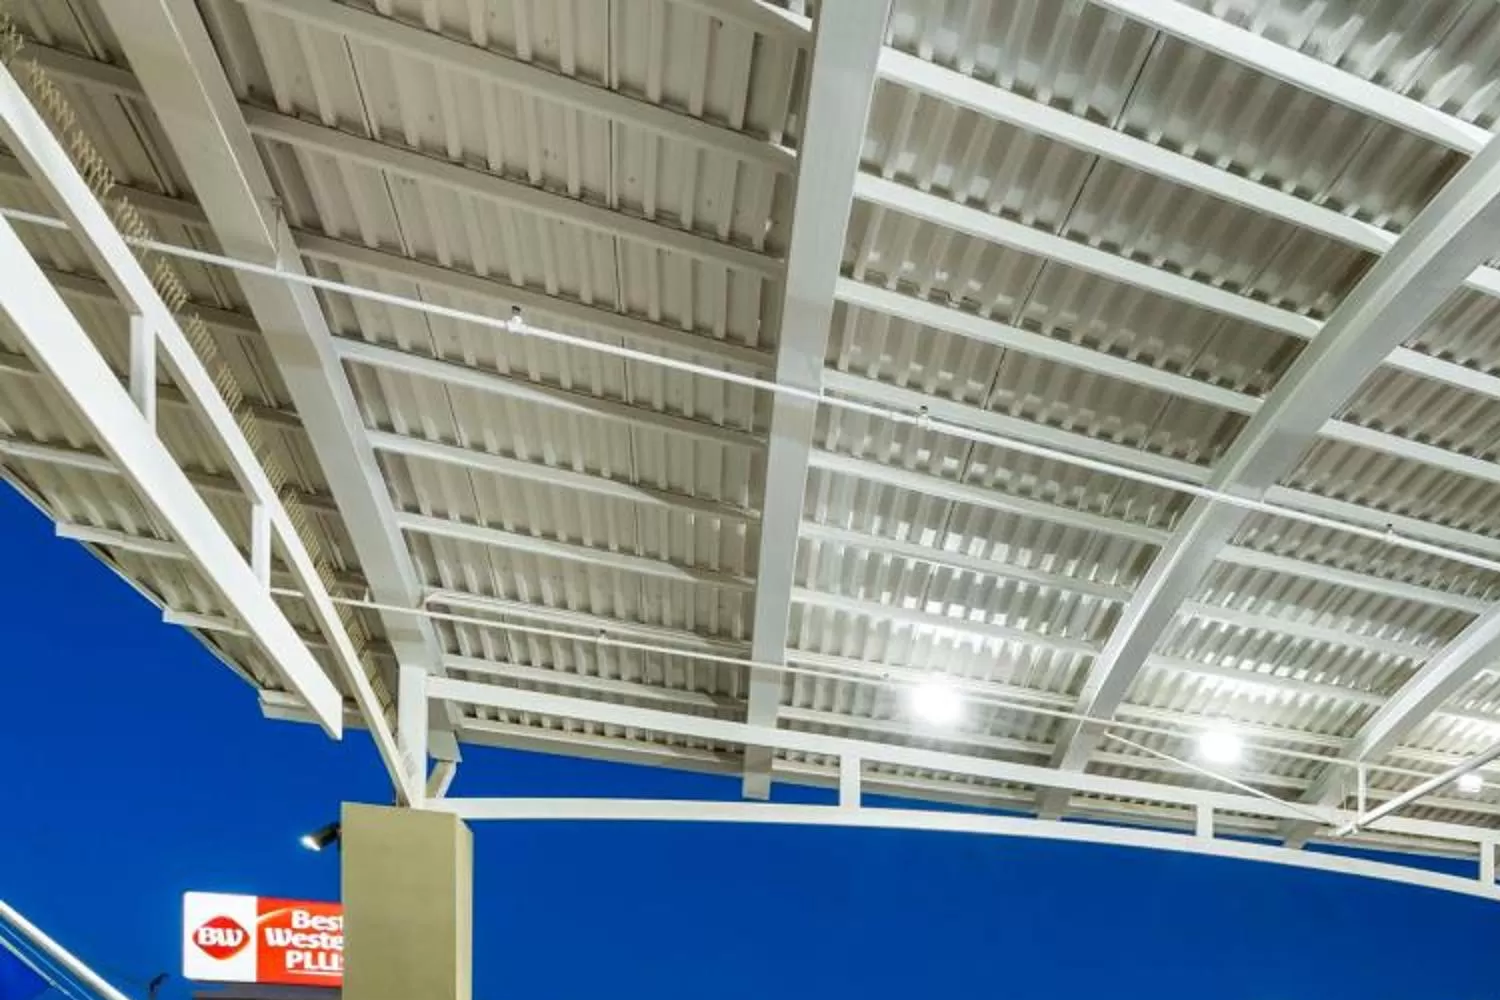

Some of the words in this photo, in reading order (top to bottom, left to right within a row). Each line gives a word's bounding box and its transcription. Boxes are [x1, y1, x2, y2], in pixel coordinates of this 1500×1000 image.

[198, 927, 244, 946] BW
[265, 927, 344, 950] Weste
[286, 950, 344, 970] PLU
